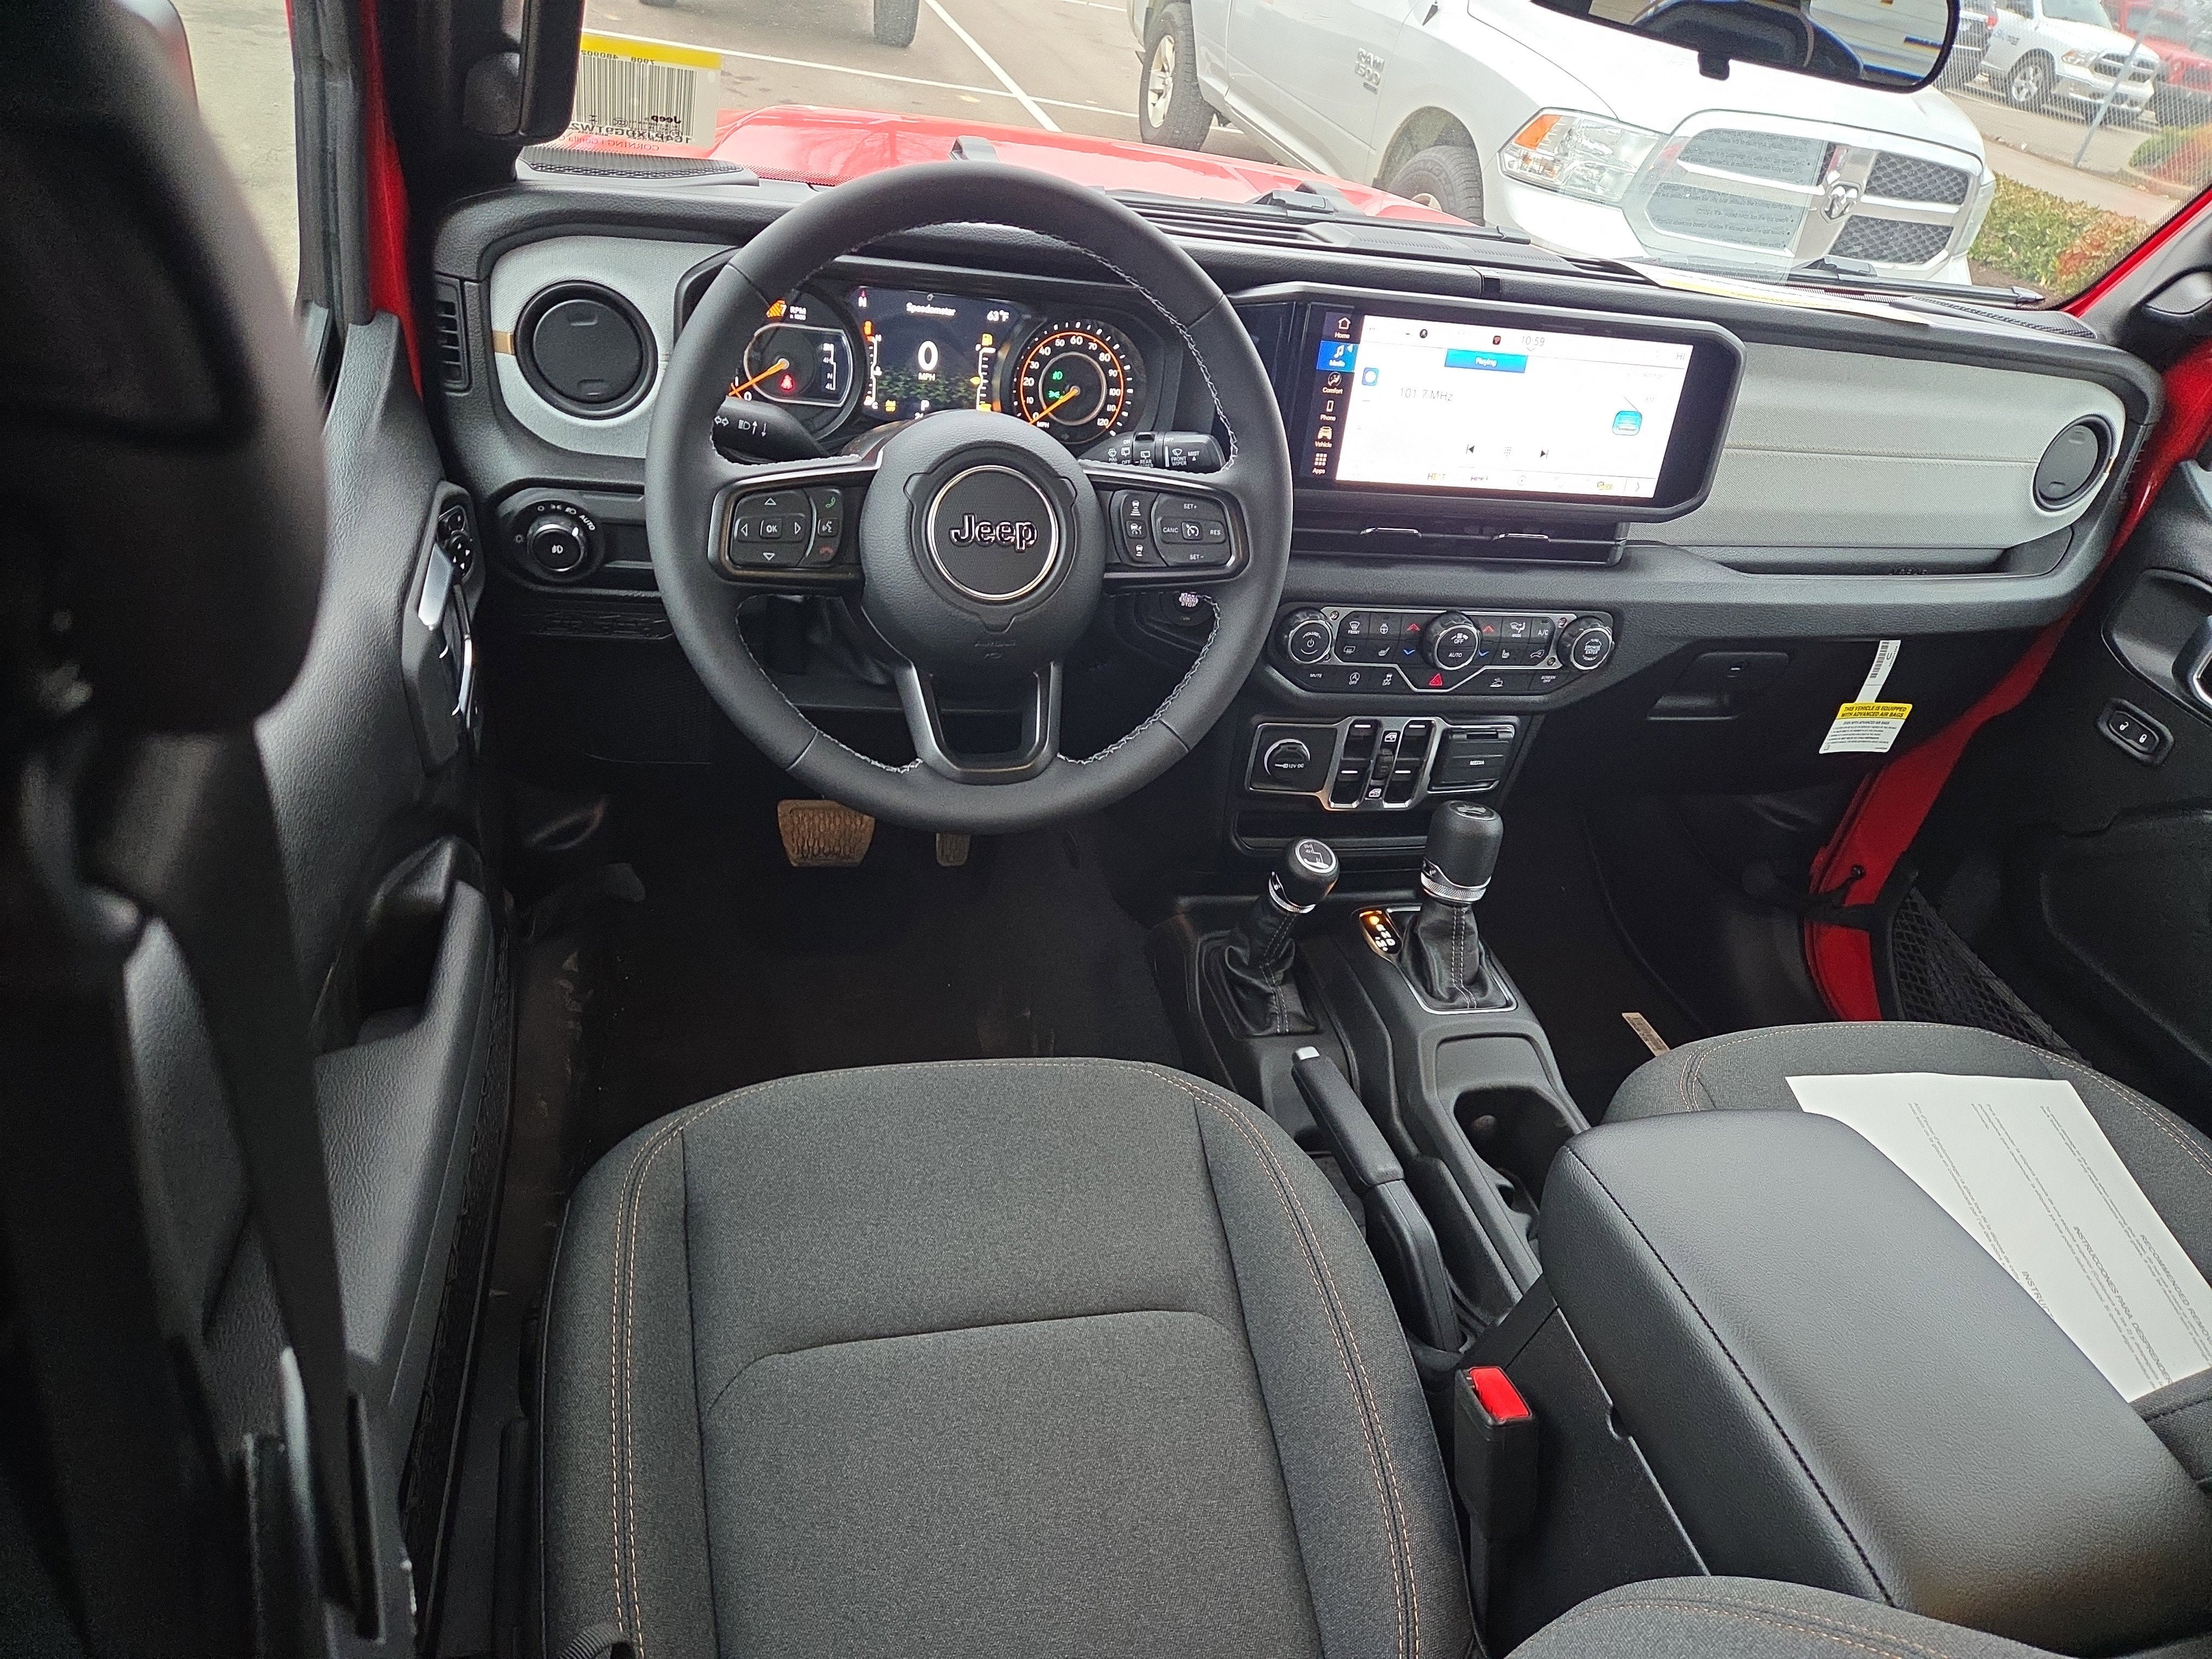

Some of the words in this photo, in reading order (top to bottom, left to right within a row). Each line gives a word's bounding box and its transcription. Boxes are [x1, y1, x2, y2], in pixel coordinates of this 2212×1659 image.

[1354, 60, 1380, 87] 1500
[789, 306, 807, 316] RPM
[906, 302, 956, 316] Speedometer
[987, 310, 1009, 322] 63°F
[1054, 338, 1065, 347] 50
[1070, 336, 1083, 345] 60
[1522, 336, 1545, 347] 10:59
[1039, 346, 1051, 356] 40
[1088, 342, 1097, 351] 70
[918, 340, 938, 371] 0
[1098, 352, 1111, 362] 80
[1030, 361, 1039, 369] 30
[1329, 359, 1346, 368] Media
[1475, 356, 1497, 367] Playing
[918, 372, 936, 381] MPH
[1108, 369, 1118, 377] 90
[1023, 377, 1035, 387] 20
[1109, 388, 1121, 396] 100
[1322, 387, 1343, 395] Comfort
[1430, 390, 1454, 401] MHz
[921, 400, 929, 411] P
[1097, 418, 1109, 427] 120
[1320, 414, 1336, 422] Phone
[1315, 440, 1333, 448] Vehicle
[579, 515, 595, 531] AUTO
[766, 525, 777, 533] OK
[950, 513, 1038, 552] Jeep
[1933, 1135, 1961, 1177] d'endommager
[1963, 1185, 1975, 1201] glace
[1973, 1202, 1982, 1214] lors
[2086, 1166, 2099, 1182] glass
[1907, 1102, 1918, 1116] avec
[1931, 1143, 1944, 1159] glace
[1969, 1206, 1977, 1217] par
[1983, 1230, 1992, 1243] des
[1990, 1243, 2002, 1261] coins
[1986, 1103, 1996, 1116] Para
[1995, 1116, 2016, 1146] desprender
[2019, 1153, 2036, 1176] etiqueta
[2053, 1205, 2062, 1218] una
[2075, 1243, 2093, 1269] superior
[2000, 1137, 2010, 1150] para
[2009, 1150, 2031, 1182] desprender
[2034, 1189, 2052, 1214] etiqueta
[2054, 1222, 2063, 1234] que
[2107, 1312, 2123, 1333] queda
[2139, 1233, 2191, 1307] RECOMMENDED
[2072, 1225, 2119, 1294] INSTRUCCIONES
[2114, 1295, 2134, 1320] PARA
[2131, 1322, 2174, 1385] DESPRENDER
